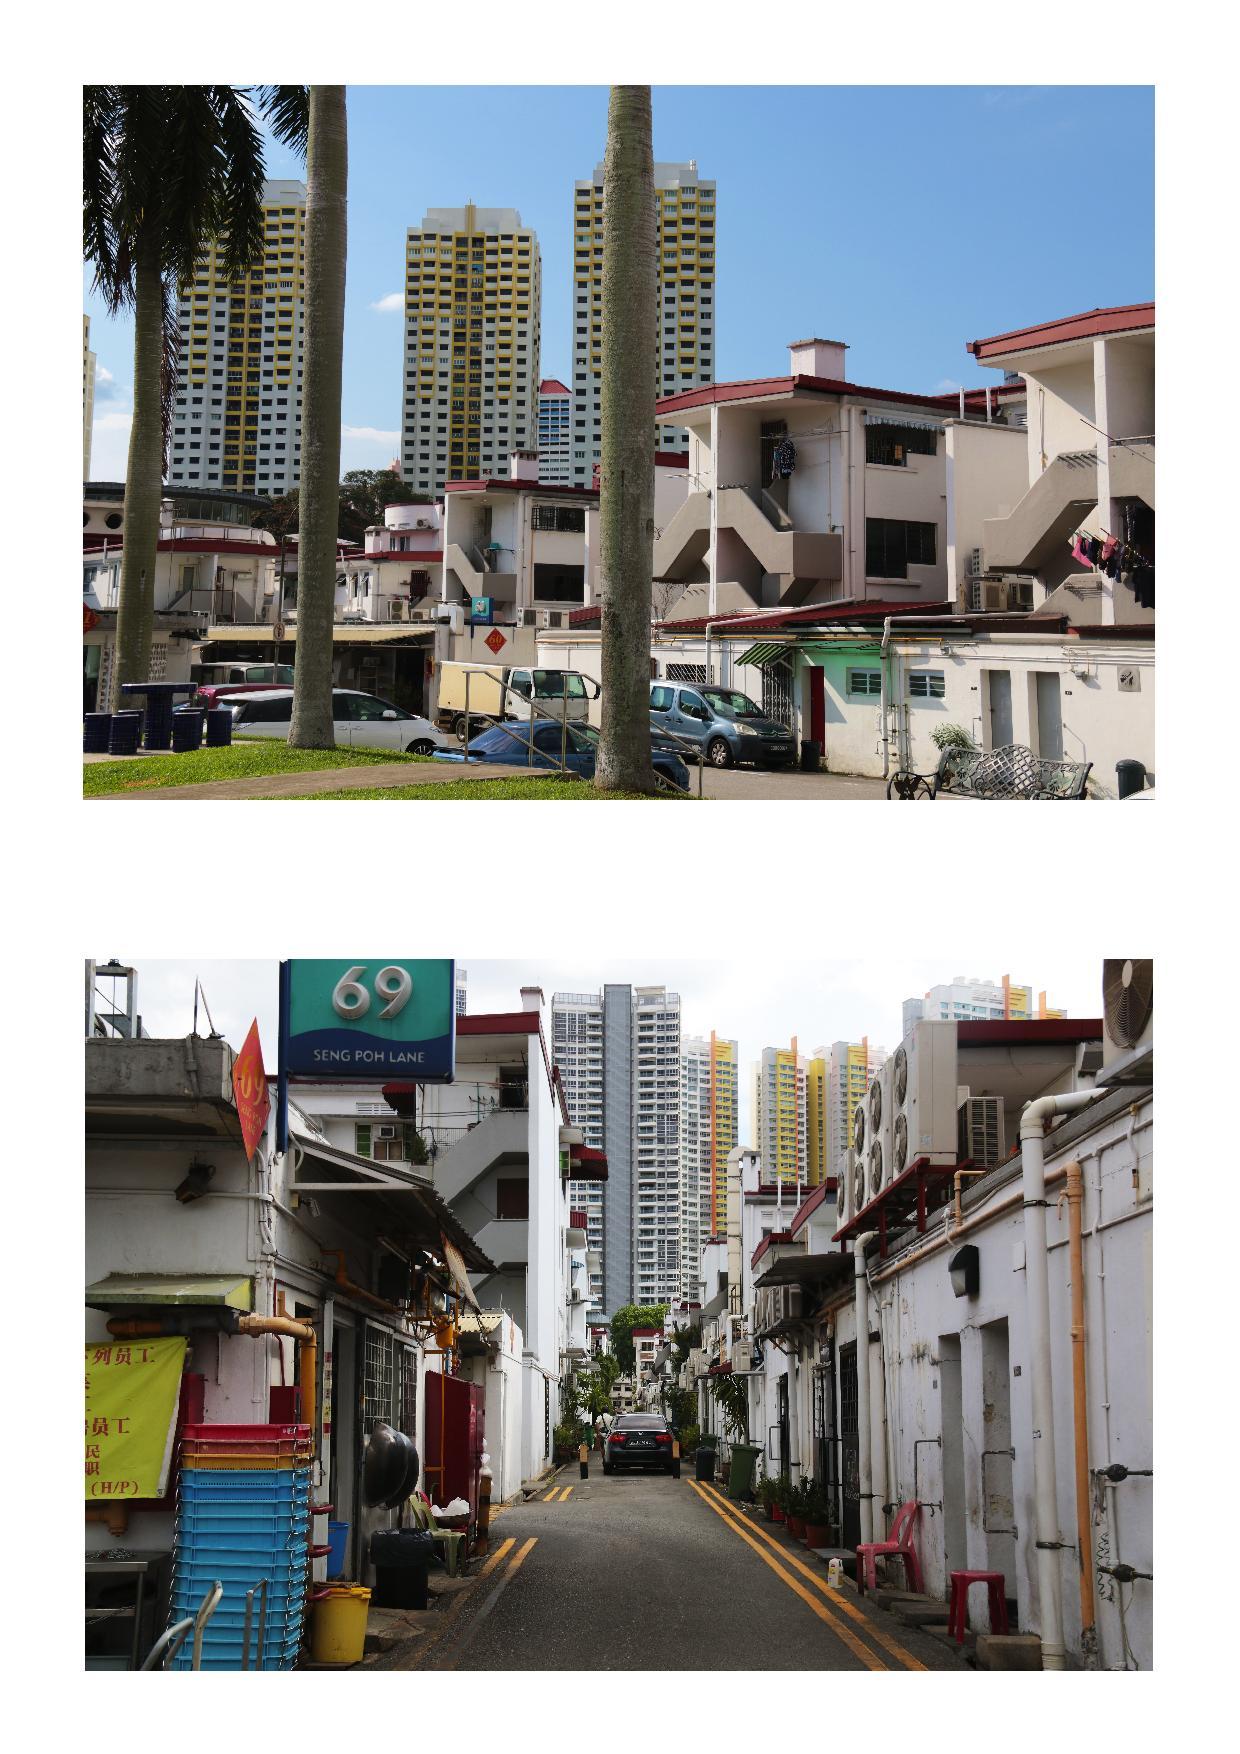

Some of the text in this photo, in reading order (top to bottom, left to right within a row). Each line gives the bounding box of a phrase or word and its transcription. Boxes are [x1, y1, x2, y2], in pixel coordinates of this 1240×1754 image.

[332, 965, 413, 1020] 69
[314, 1049, 425, 1064] SENG POH LANE
[241, 1055, 264, 1106] 69
[91, 1481, 139, 1497] (H/P)
